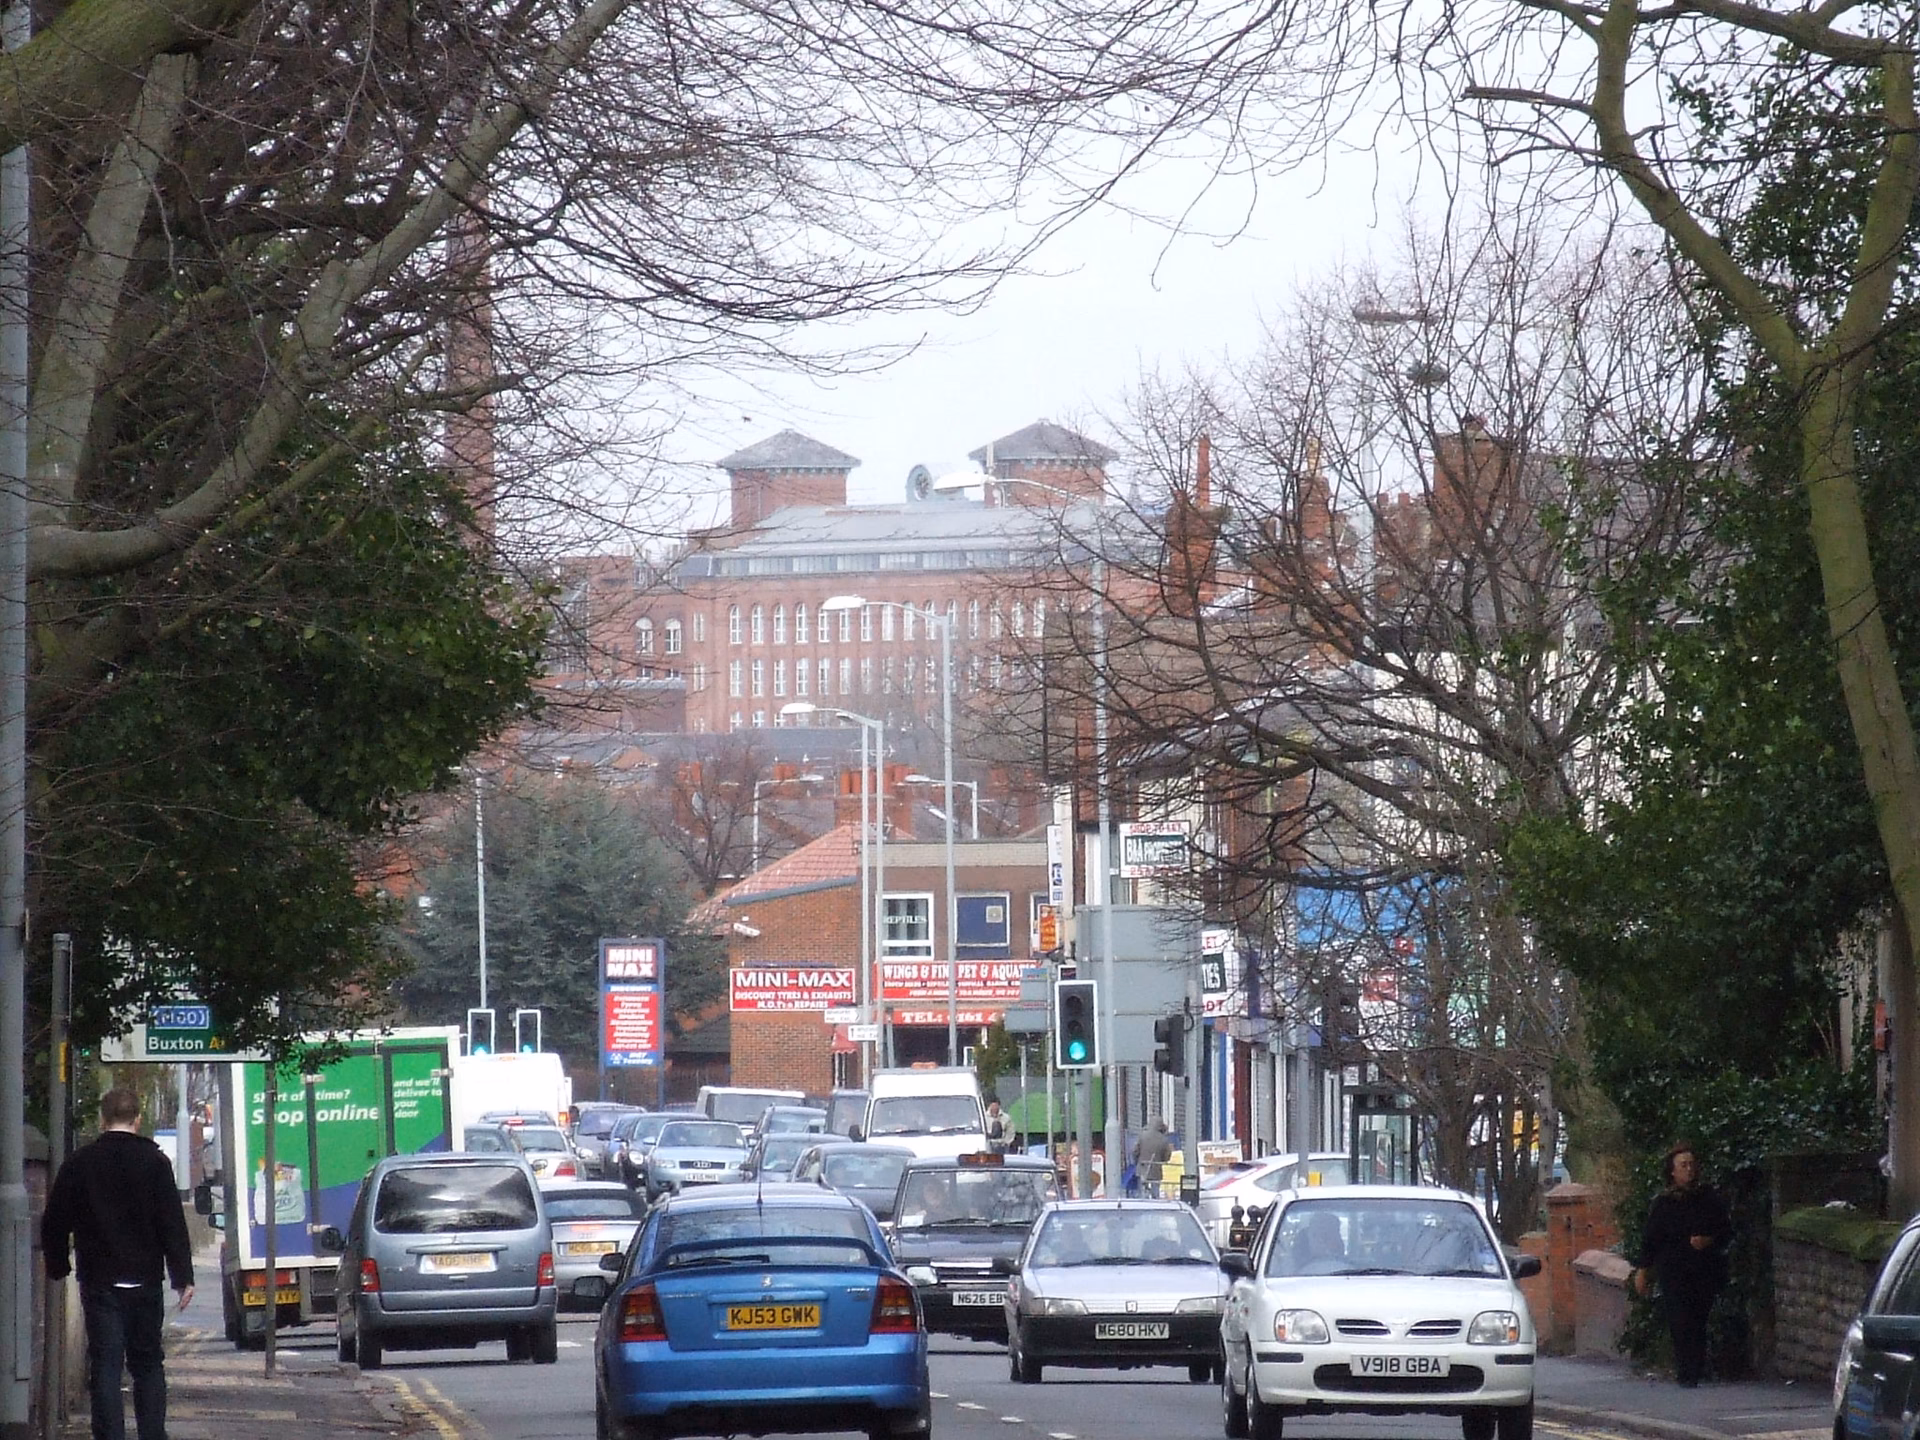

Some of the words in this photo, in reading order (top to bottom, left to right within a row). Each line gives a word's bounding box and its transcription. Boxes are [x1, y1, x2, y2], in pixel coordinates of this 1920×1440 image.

[608, 949, 652, 963] MINI
[607, 963, 653, 977] MAX
[884, 965, 918, 979] WINGS
[921, 965, 930, 979] &
[958, 964, 977, 978] PET
[981, 964, 989, 978] &
[736, 972, 850, 988] MINI-MAX
[735, 991, 775, 999] DISCOUNT
[777, 991, 801, 999] TYRES
[812, 991, 852, 999] EXHAUSTS
[794, 1001, 829, 1009] REPAIRS
[149, 1037, 204, 1050] Buxton
[291, 1091, 305, 1101] of
[316, 1089, 350, 1101] time?
[393, 1089, 430, 1097] deliver
[393, 1100, 418, 1110] your
[251, 1108, 304, 1127] Sop
[316, 1104, 379, 1122] online
[394, 1109, 419, 1118] door
[958, 1293, 986, 1304] N626
[731, 1308, 777, 1325] KJ53
[781, 1306, 815, 1323] GWK
[1098, 1324, 1136, 1336] M680
[1138, 1324, 1167, 1336] HKV
[1360, 1357, 1401, 1373] V918
[1406, 1357, 1442, 1373] GBA
